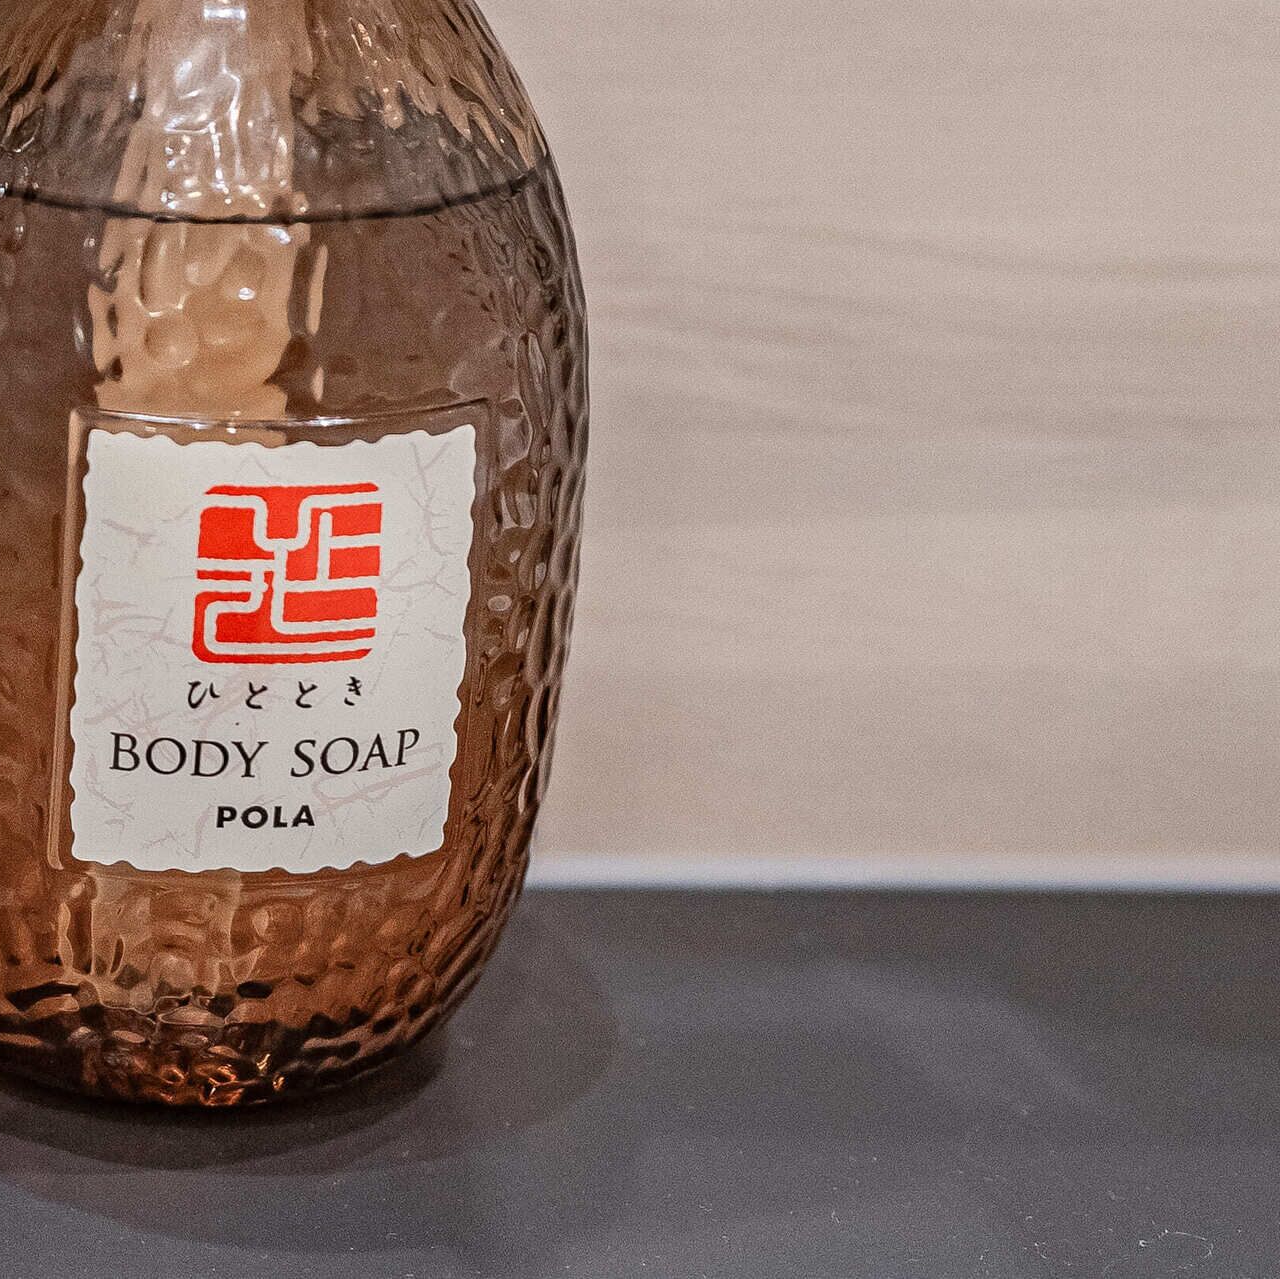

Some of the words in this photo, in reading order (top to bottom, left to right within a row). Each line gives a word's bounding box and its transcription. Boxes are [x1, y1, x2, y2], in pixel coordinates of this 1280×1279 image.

[187, 676, 363, 710] ひととき
[108, 731, 269, 779] BODY
[290, 728, 421, 778] SOAP
[216, 803, 316, 829] POLA
